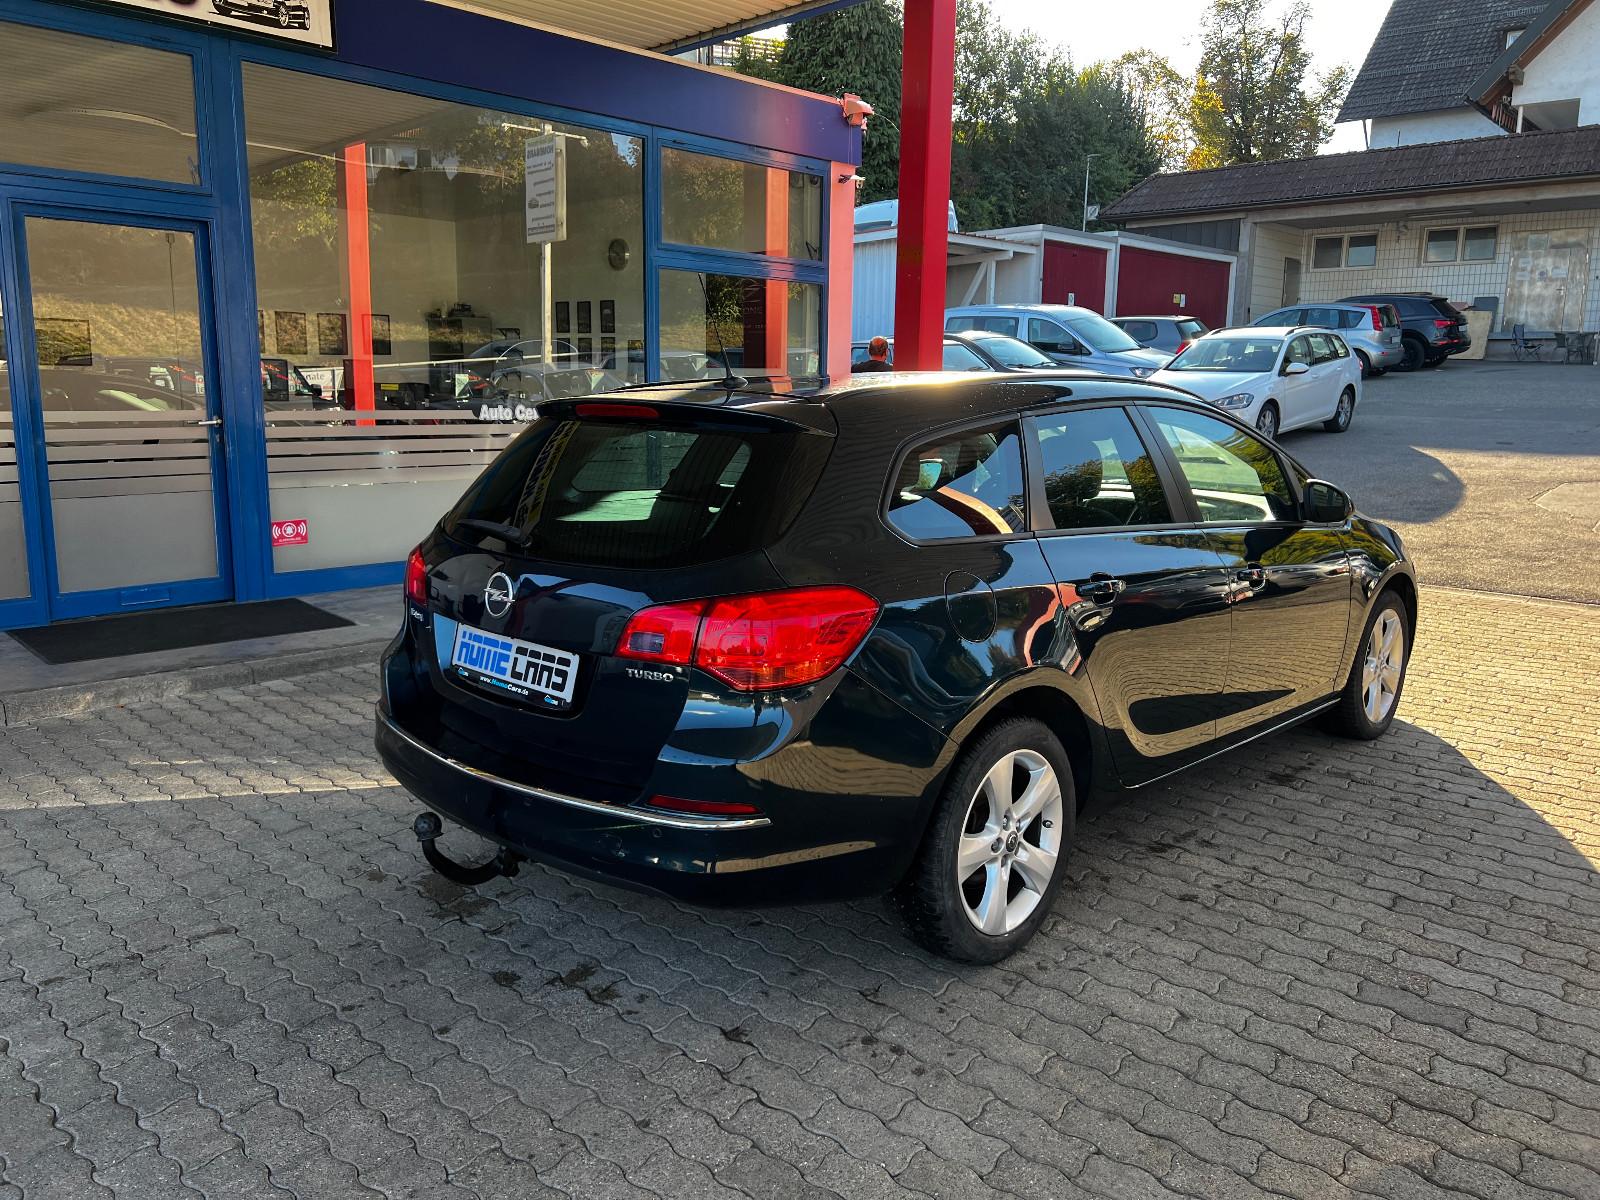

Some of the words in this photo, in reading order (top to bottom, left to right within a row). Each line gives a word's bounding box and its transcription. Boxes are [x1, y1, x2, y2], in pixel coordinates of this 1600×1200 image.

[479, 404, 513, 420] Auto
[458, 631, 512, 676] HOME
[511, 646, 571, 692] CARS
[625, 668, 674, 682] TURBO
